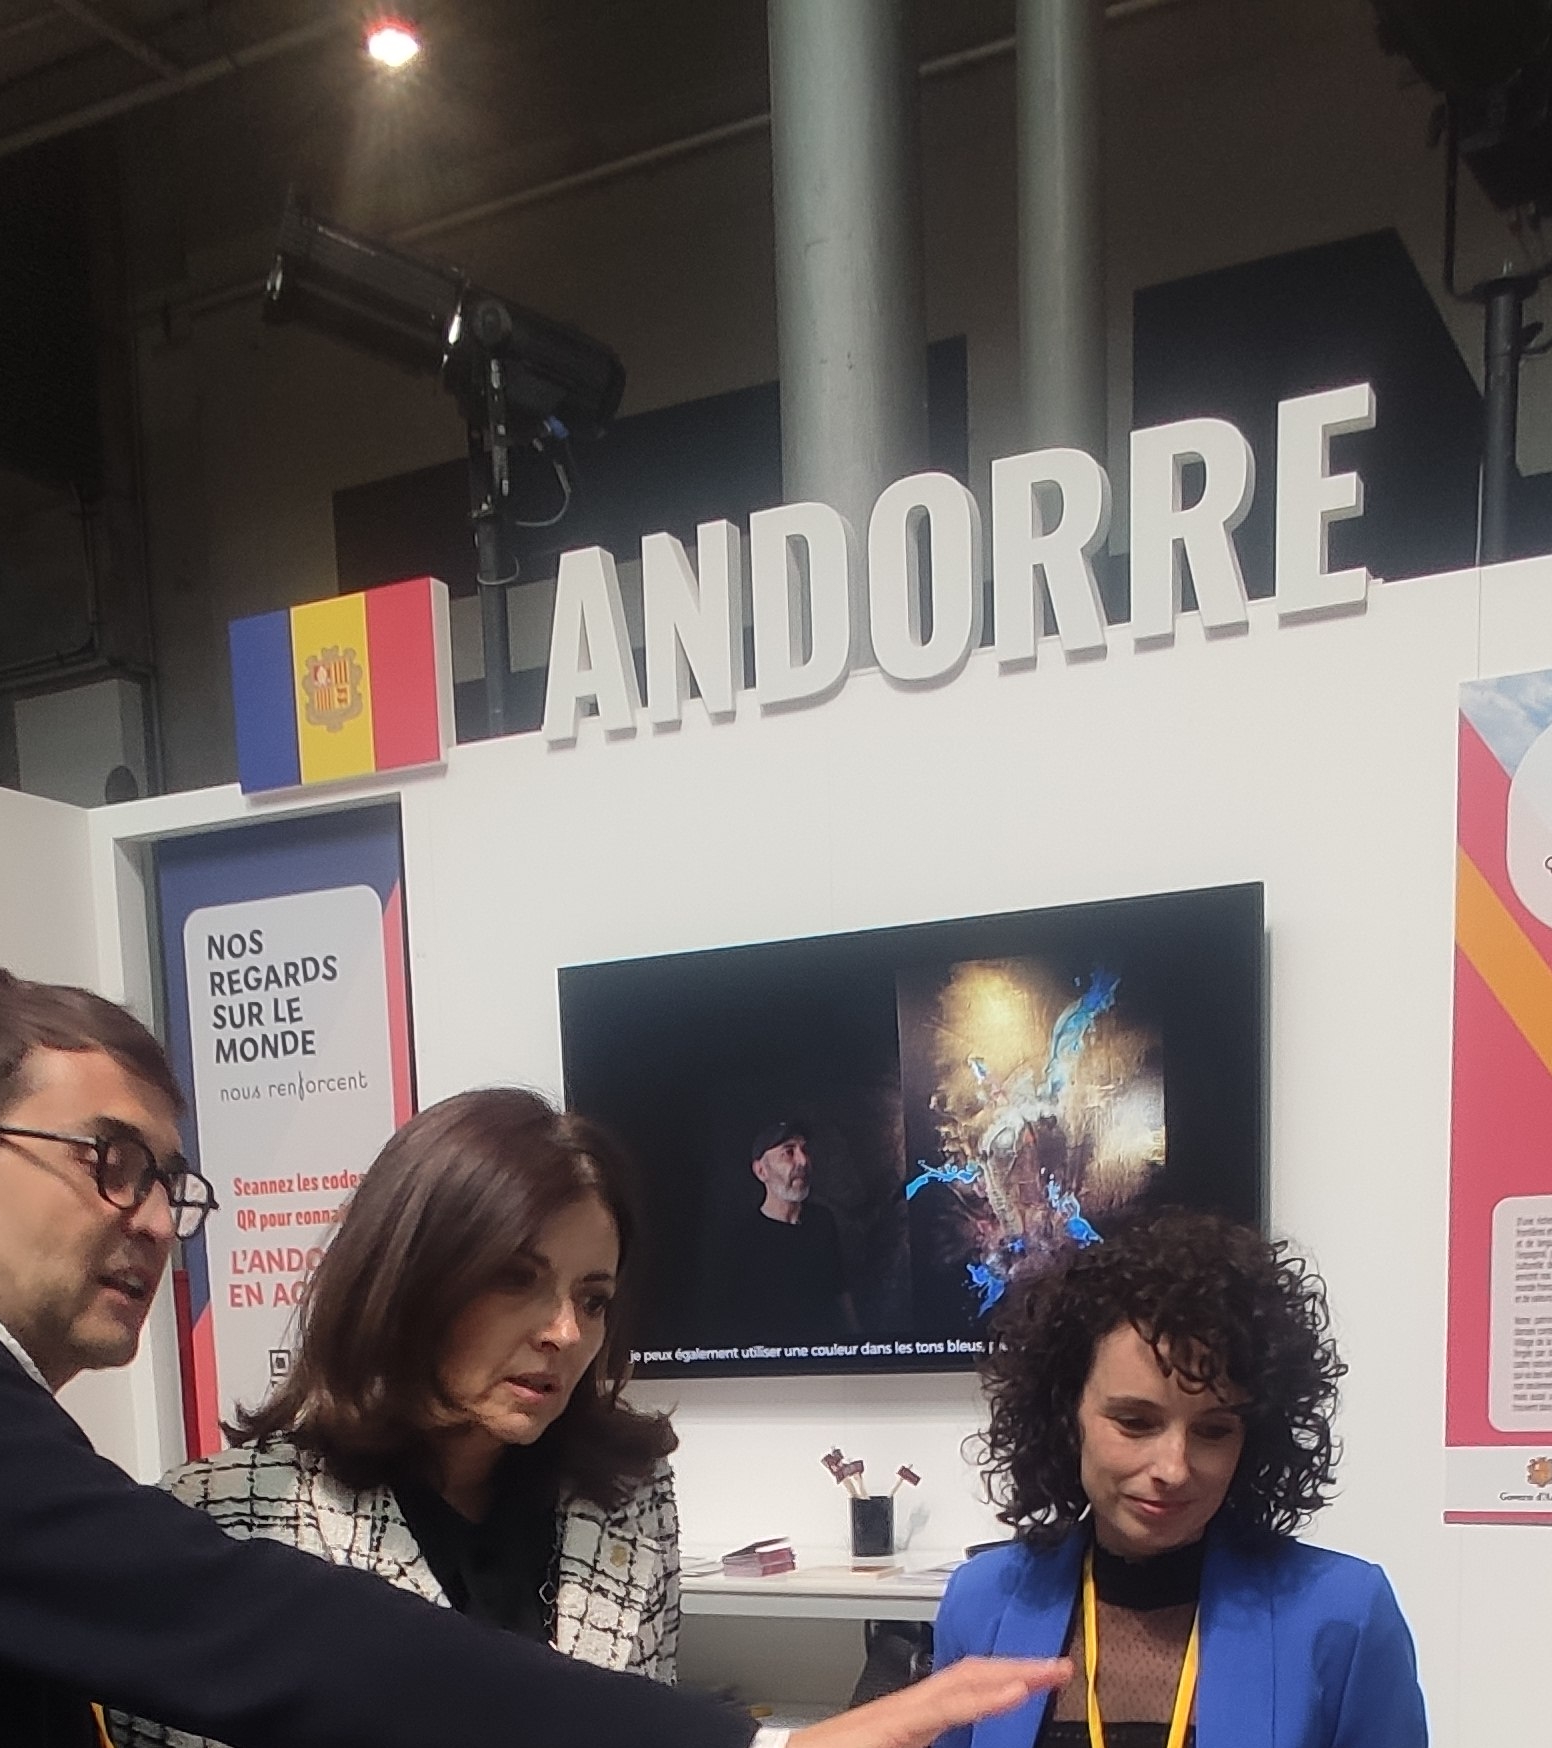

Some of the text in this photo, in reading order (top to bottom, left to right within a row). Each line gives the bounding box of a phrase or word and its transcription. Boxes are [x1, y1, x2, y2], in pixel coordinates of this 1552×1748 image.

[542, 384, 1376, 744] ANDORRE
[207, 929, 264, 961] NOS
[209, 955, 338, 997] REGARDS
[212, 996, 303, 1030] SUR LE
[215, 1030, 317, 1064] MONDE
[220, 1070, 368, 1101] nous renforcent
[233, 1177, 293, 1197] Scannez
[297, 1173, 319, 1192] les
[236, 1209, 257, 1231] QR
[260, 1212, 292, 1231] pour
[229, 1281, 264, 1308] EN
[628, 1349, 641, 1364] je
[643, 1350, 674, 1364] peux
[674, 1346, 739, 1363] également
[741, 1345, 782, 1360] utiliser
[784, 1347, 809, 1358] une
[810, 1343, 859, 1357] couleur
[861, 1342, 893, 1355] dans
[894, 1341, 914, 1355] les
[915, 1342, 944, 1354] tons
[946, 1339, 986, 1355] bleus,
